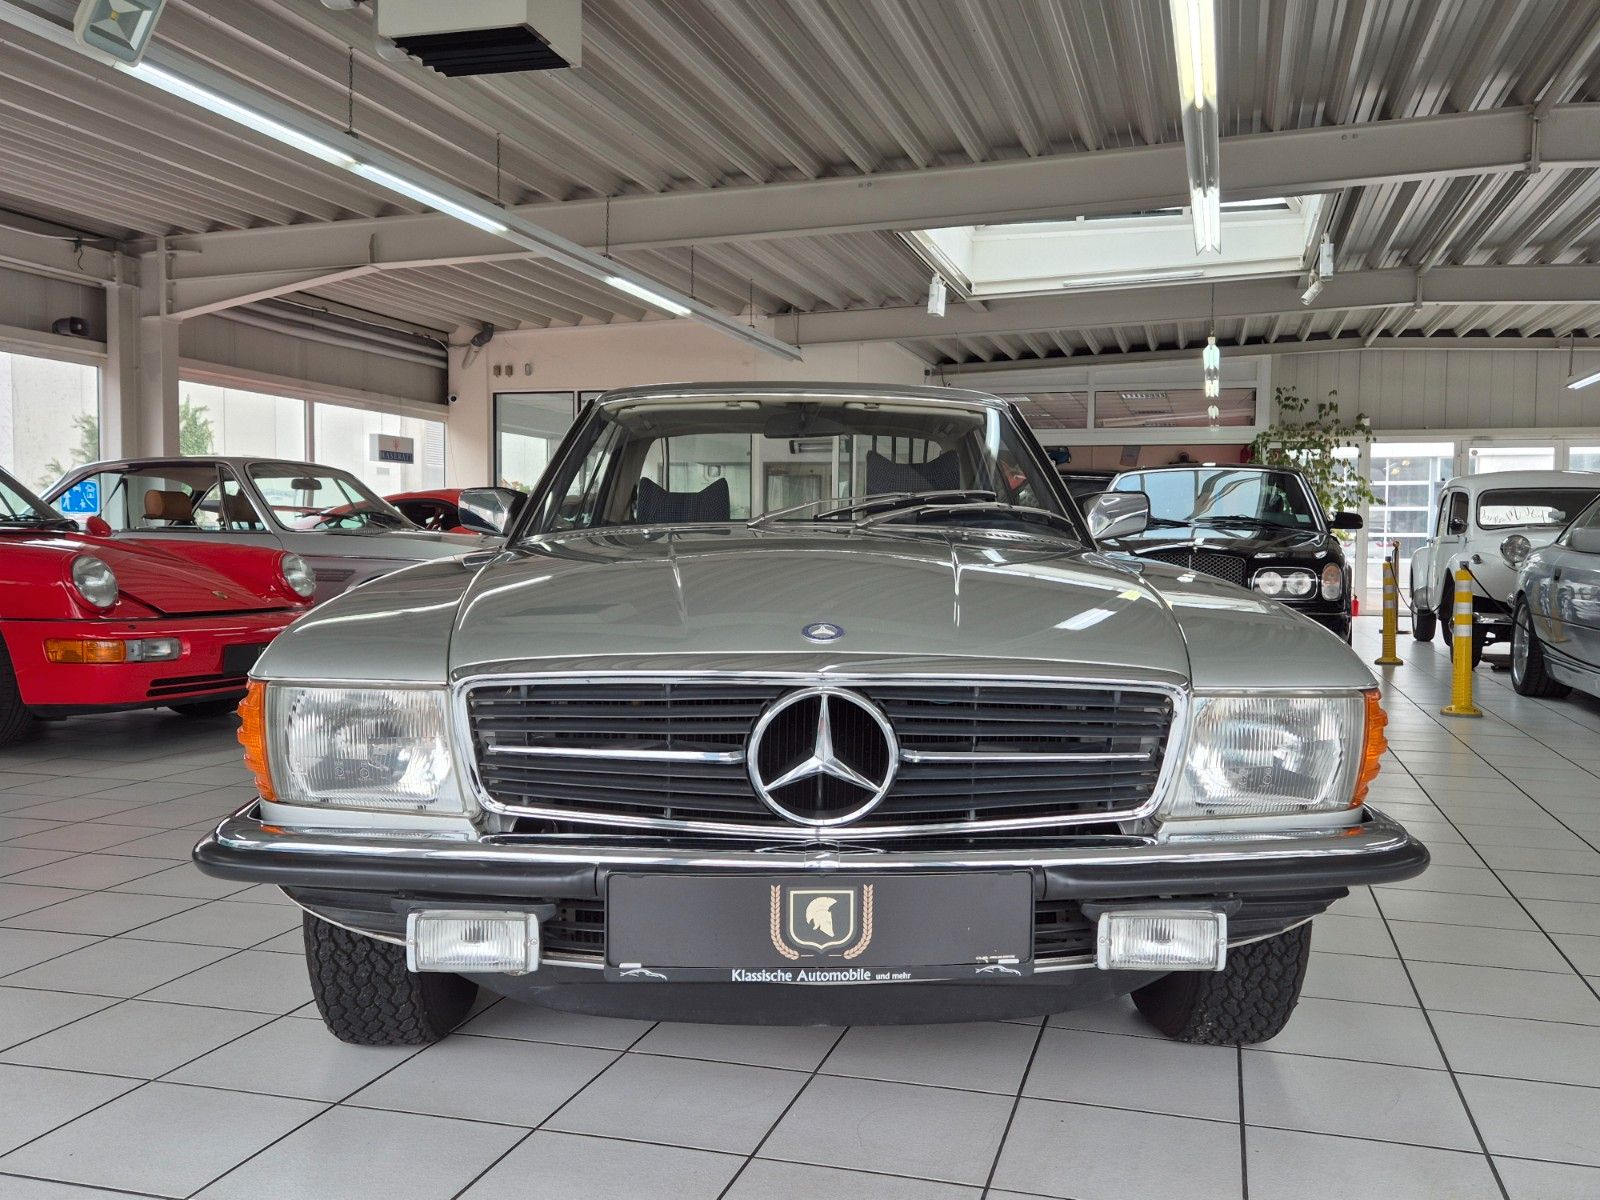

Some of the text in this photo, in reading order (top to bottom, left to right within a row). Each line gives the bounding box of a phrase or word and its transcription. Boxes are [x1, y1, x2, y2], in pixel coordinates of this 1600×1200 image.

[731, 968, 911, 982] Klassische Automobile und mehr
